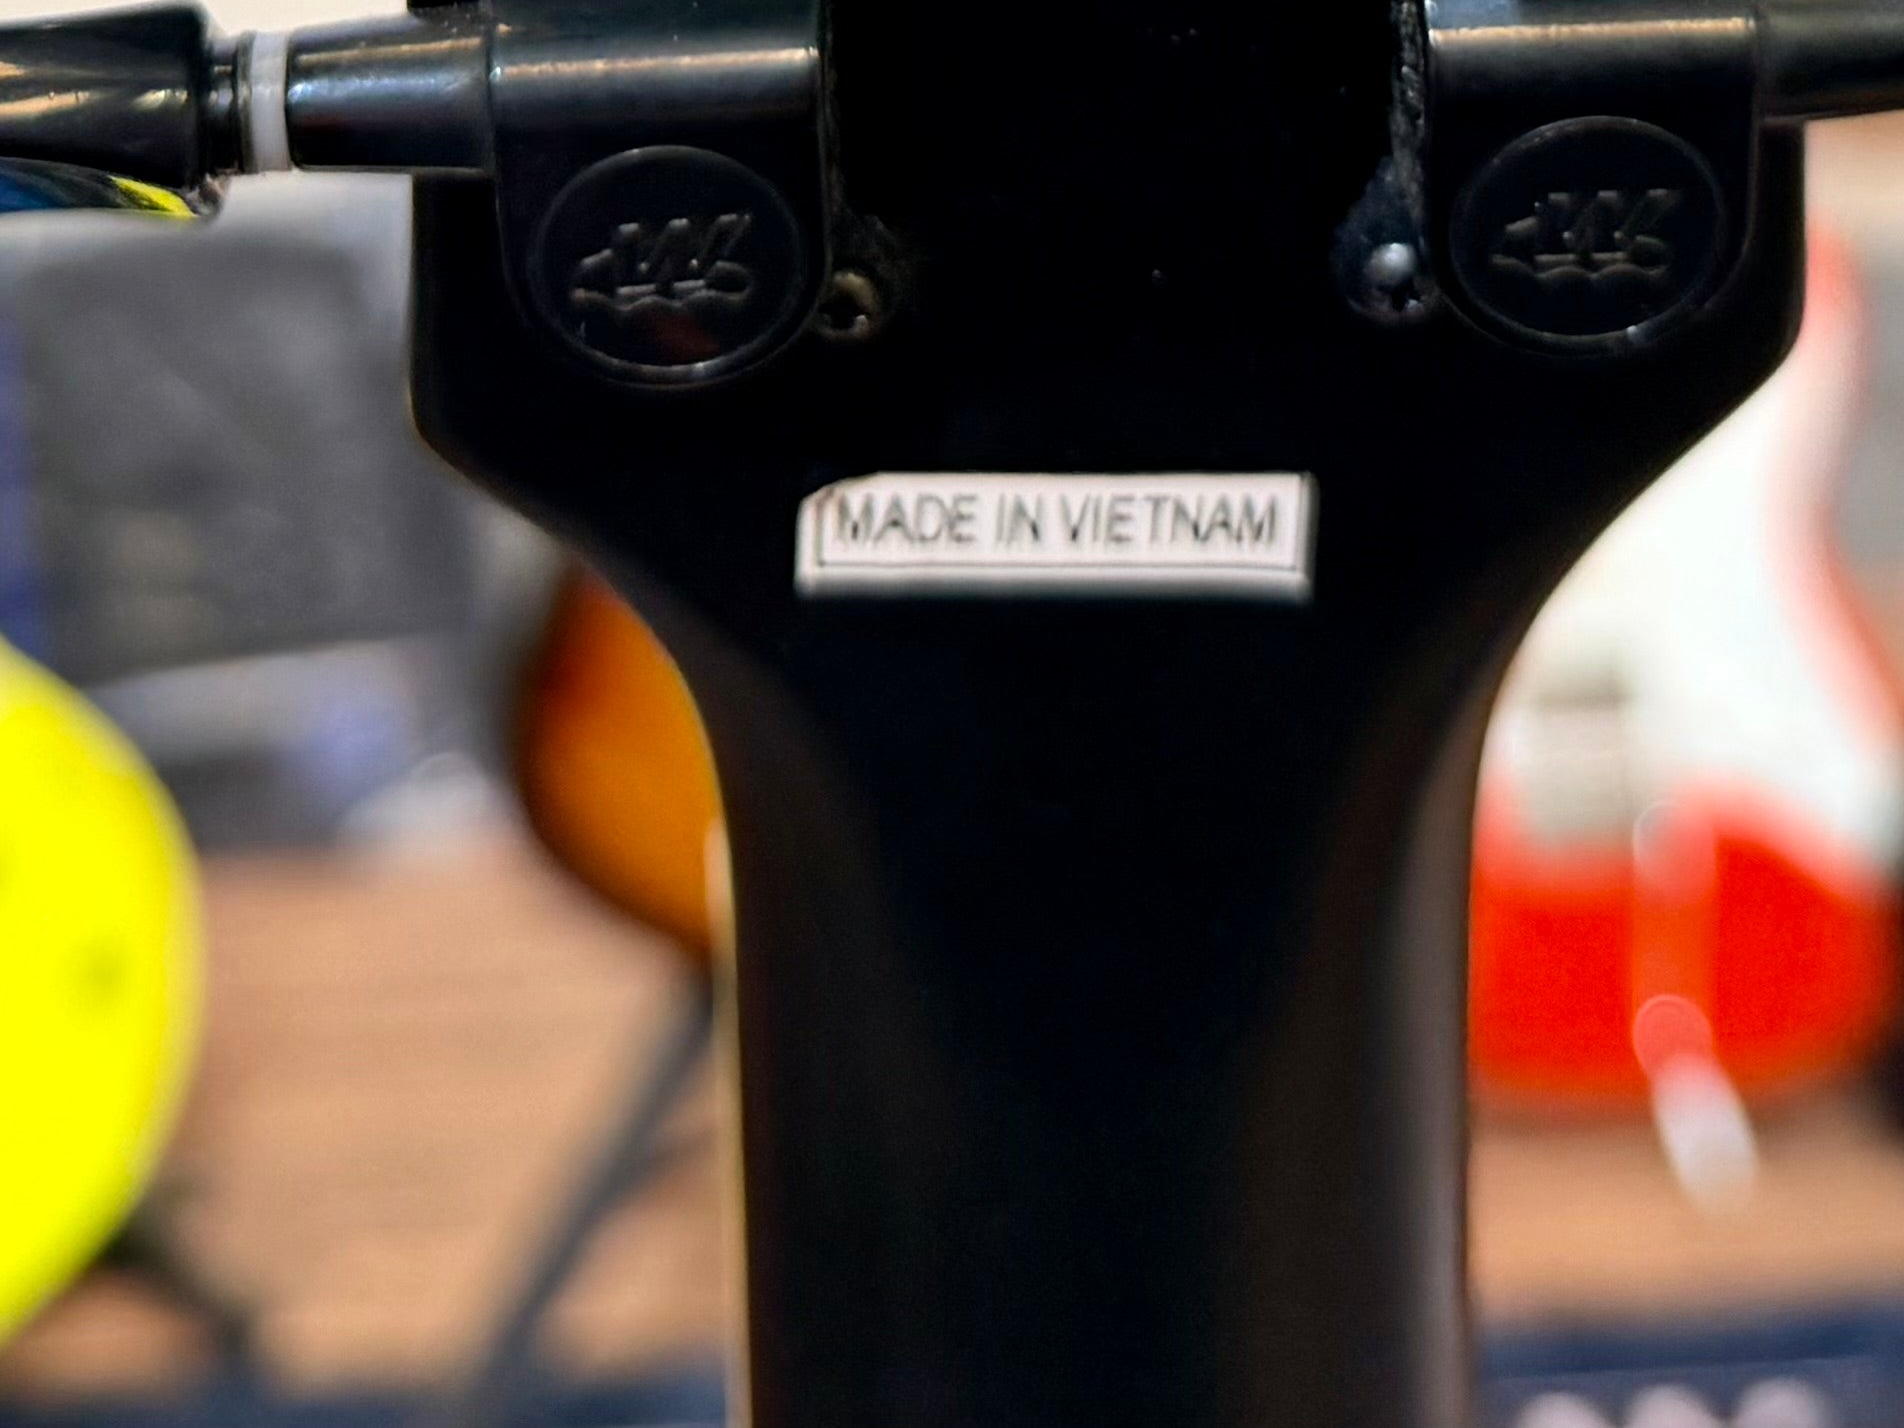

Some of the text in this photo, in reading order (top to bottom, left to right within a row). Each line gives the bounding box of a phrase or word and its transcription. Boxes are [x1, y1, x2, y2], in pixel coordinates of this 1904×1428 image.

[834, 491, 1279, 546] MADE IN VIETNAM
